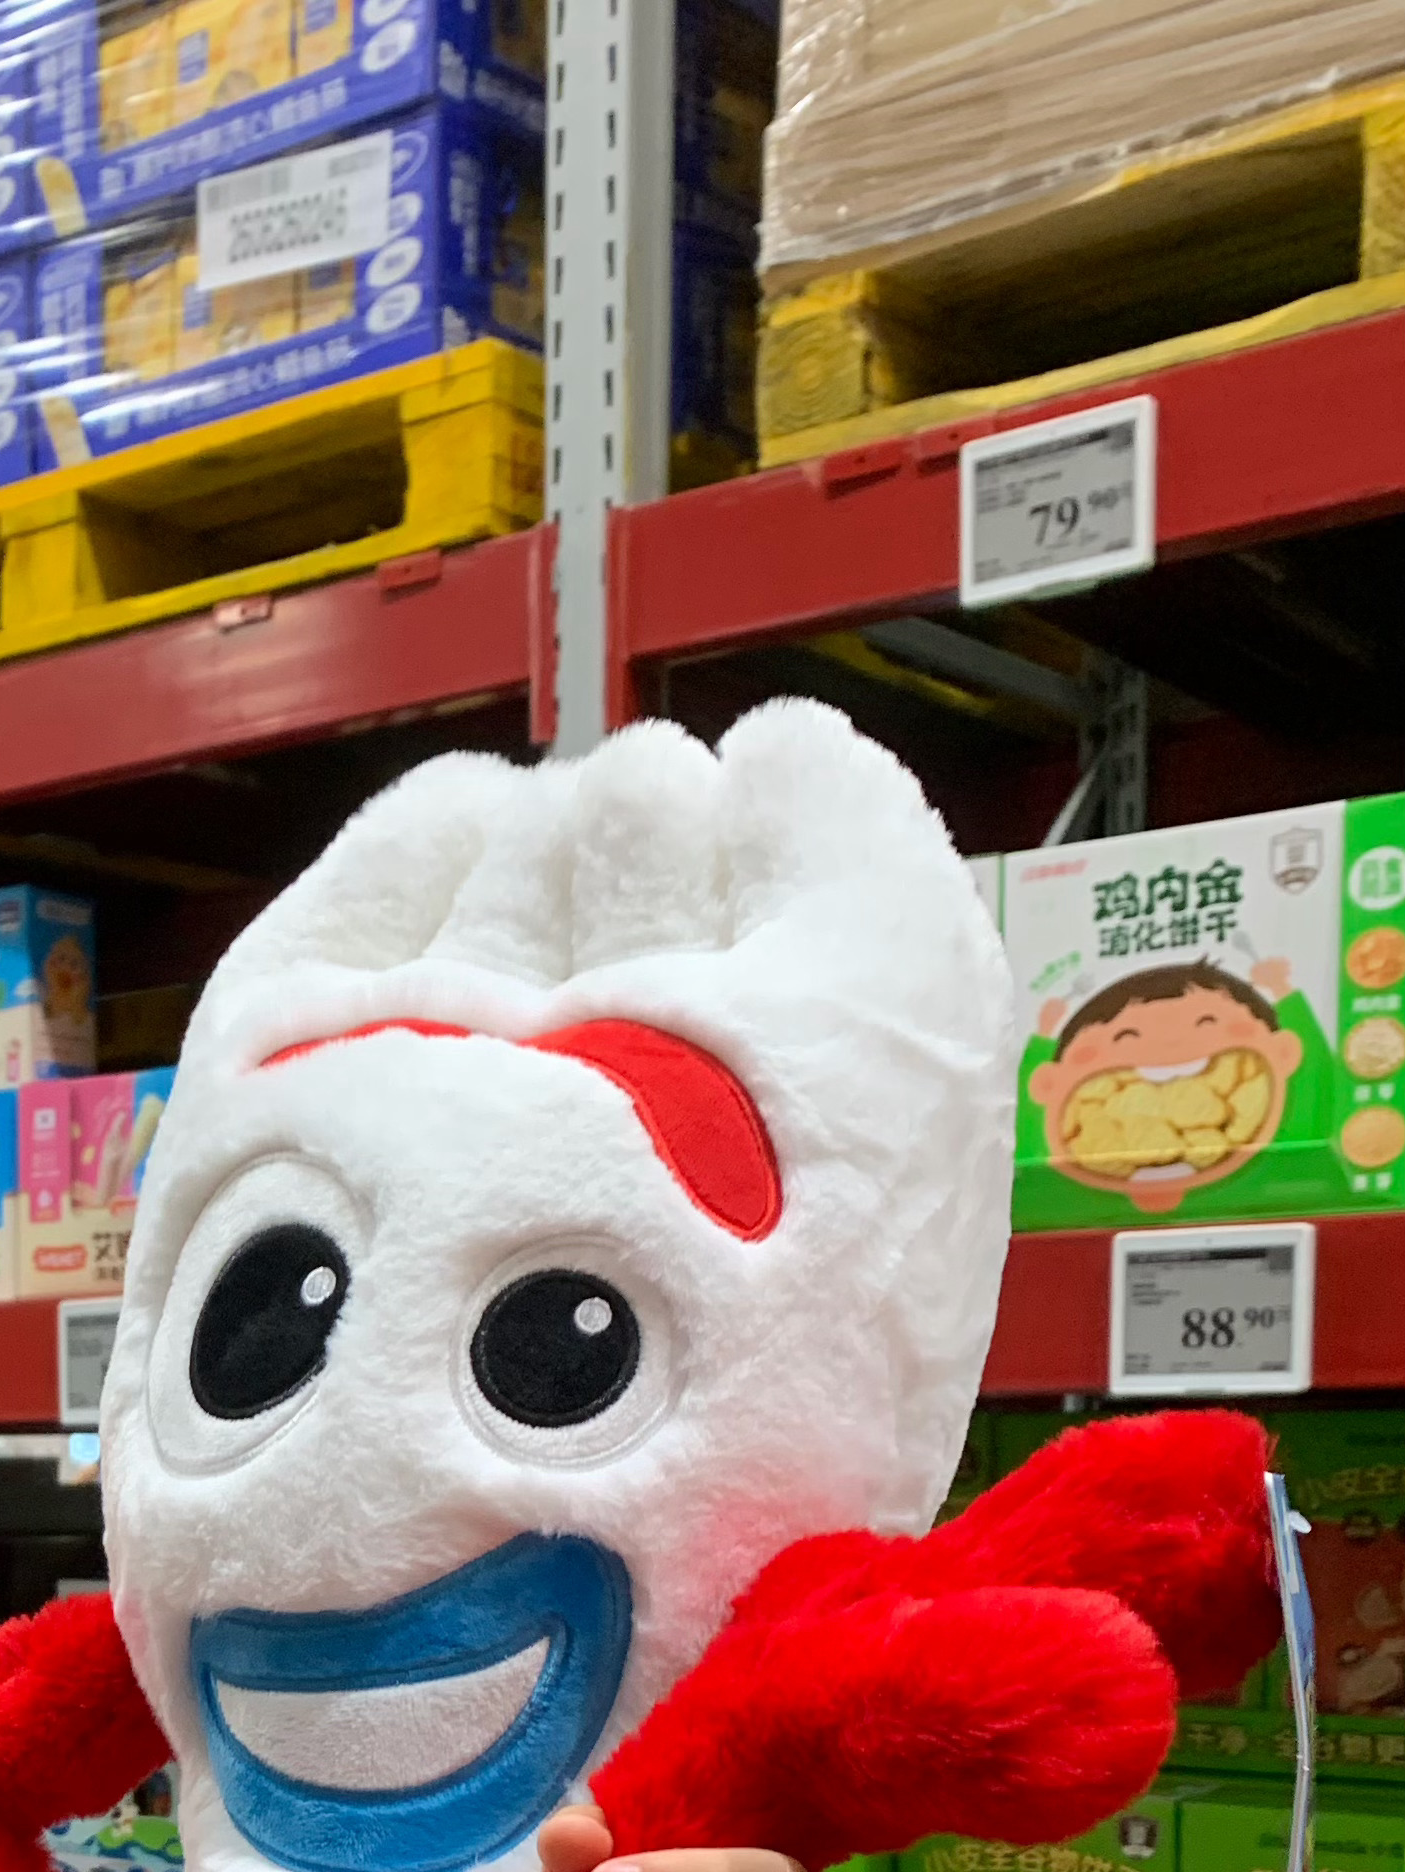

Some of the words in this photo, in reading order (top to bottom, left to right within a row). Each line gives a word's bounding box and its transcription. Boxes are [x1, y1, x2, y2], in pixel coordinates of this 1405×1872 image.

[1029, 497, 1080, 547] 79
[1093, 857, 1243, 922] 鸡内金
[1099, 909, 1237, 957] 消化饼干
[1182, 1307, 1235, 1349] 88
